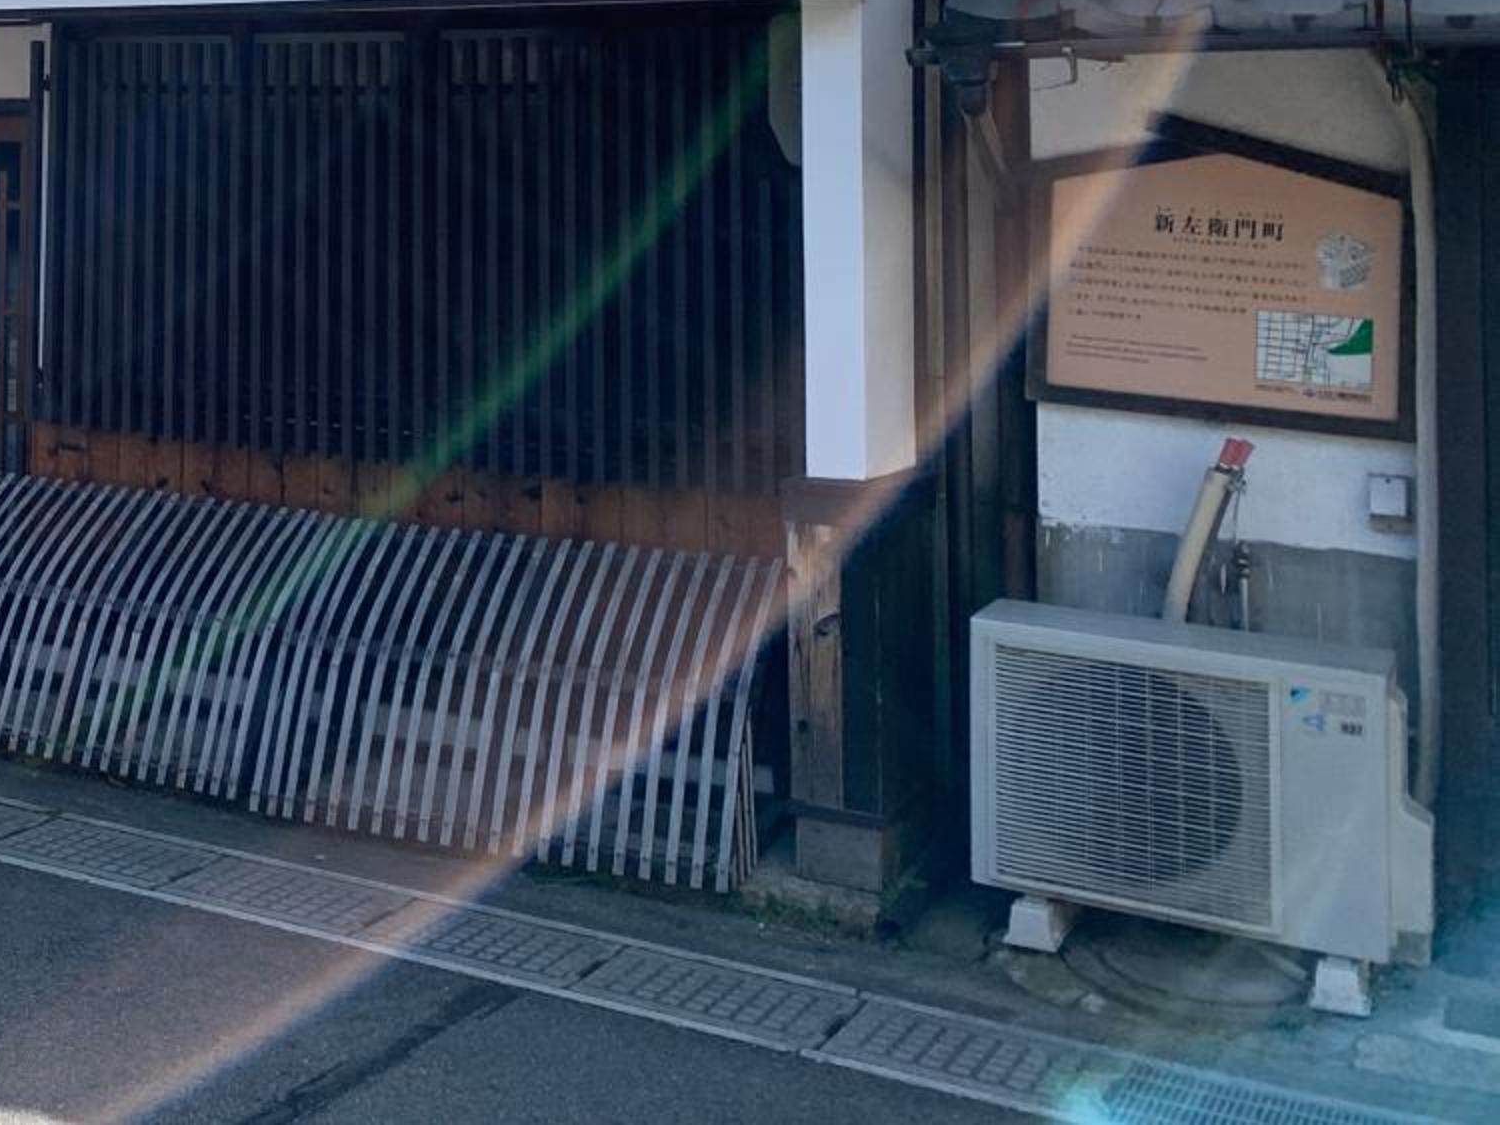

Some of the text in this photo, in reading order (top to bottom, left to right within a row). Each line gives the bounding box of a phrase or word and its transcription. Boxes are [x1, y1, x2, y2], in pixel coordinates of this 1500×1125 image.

[1155, 214, 1284, 241] 新左衛門町
